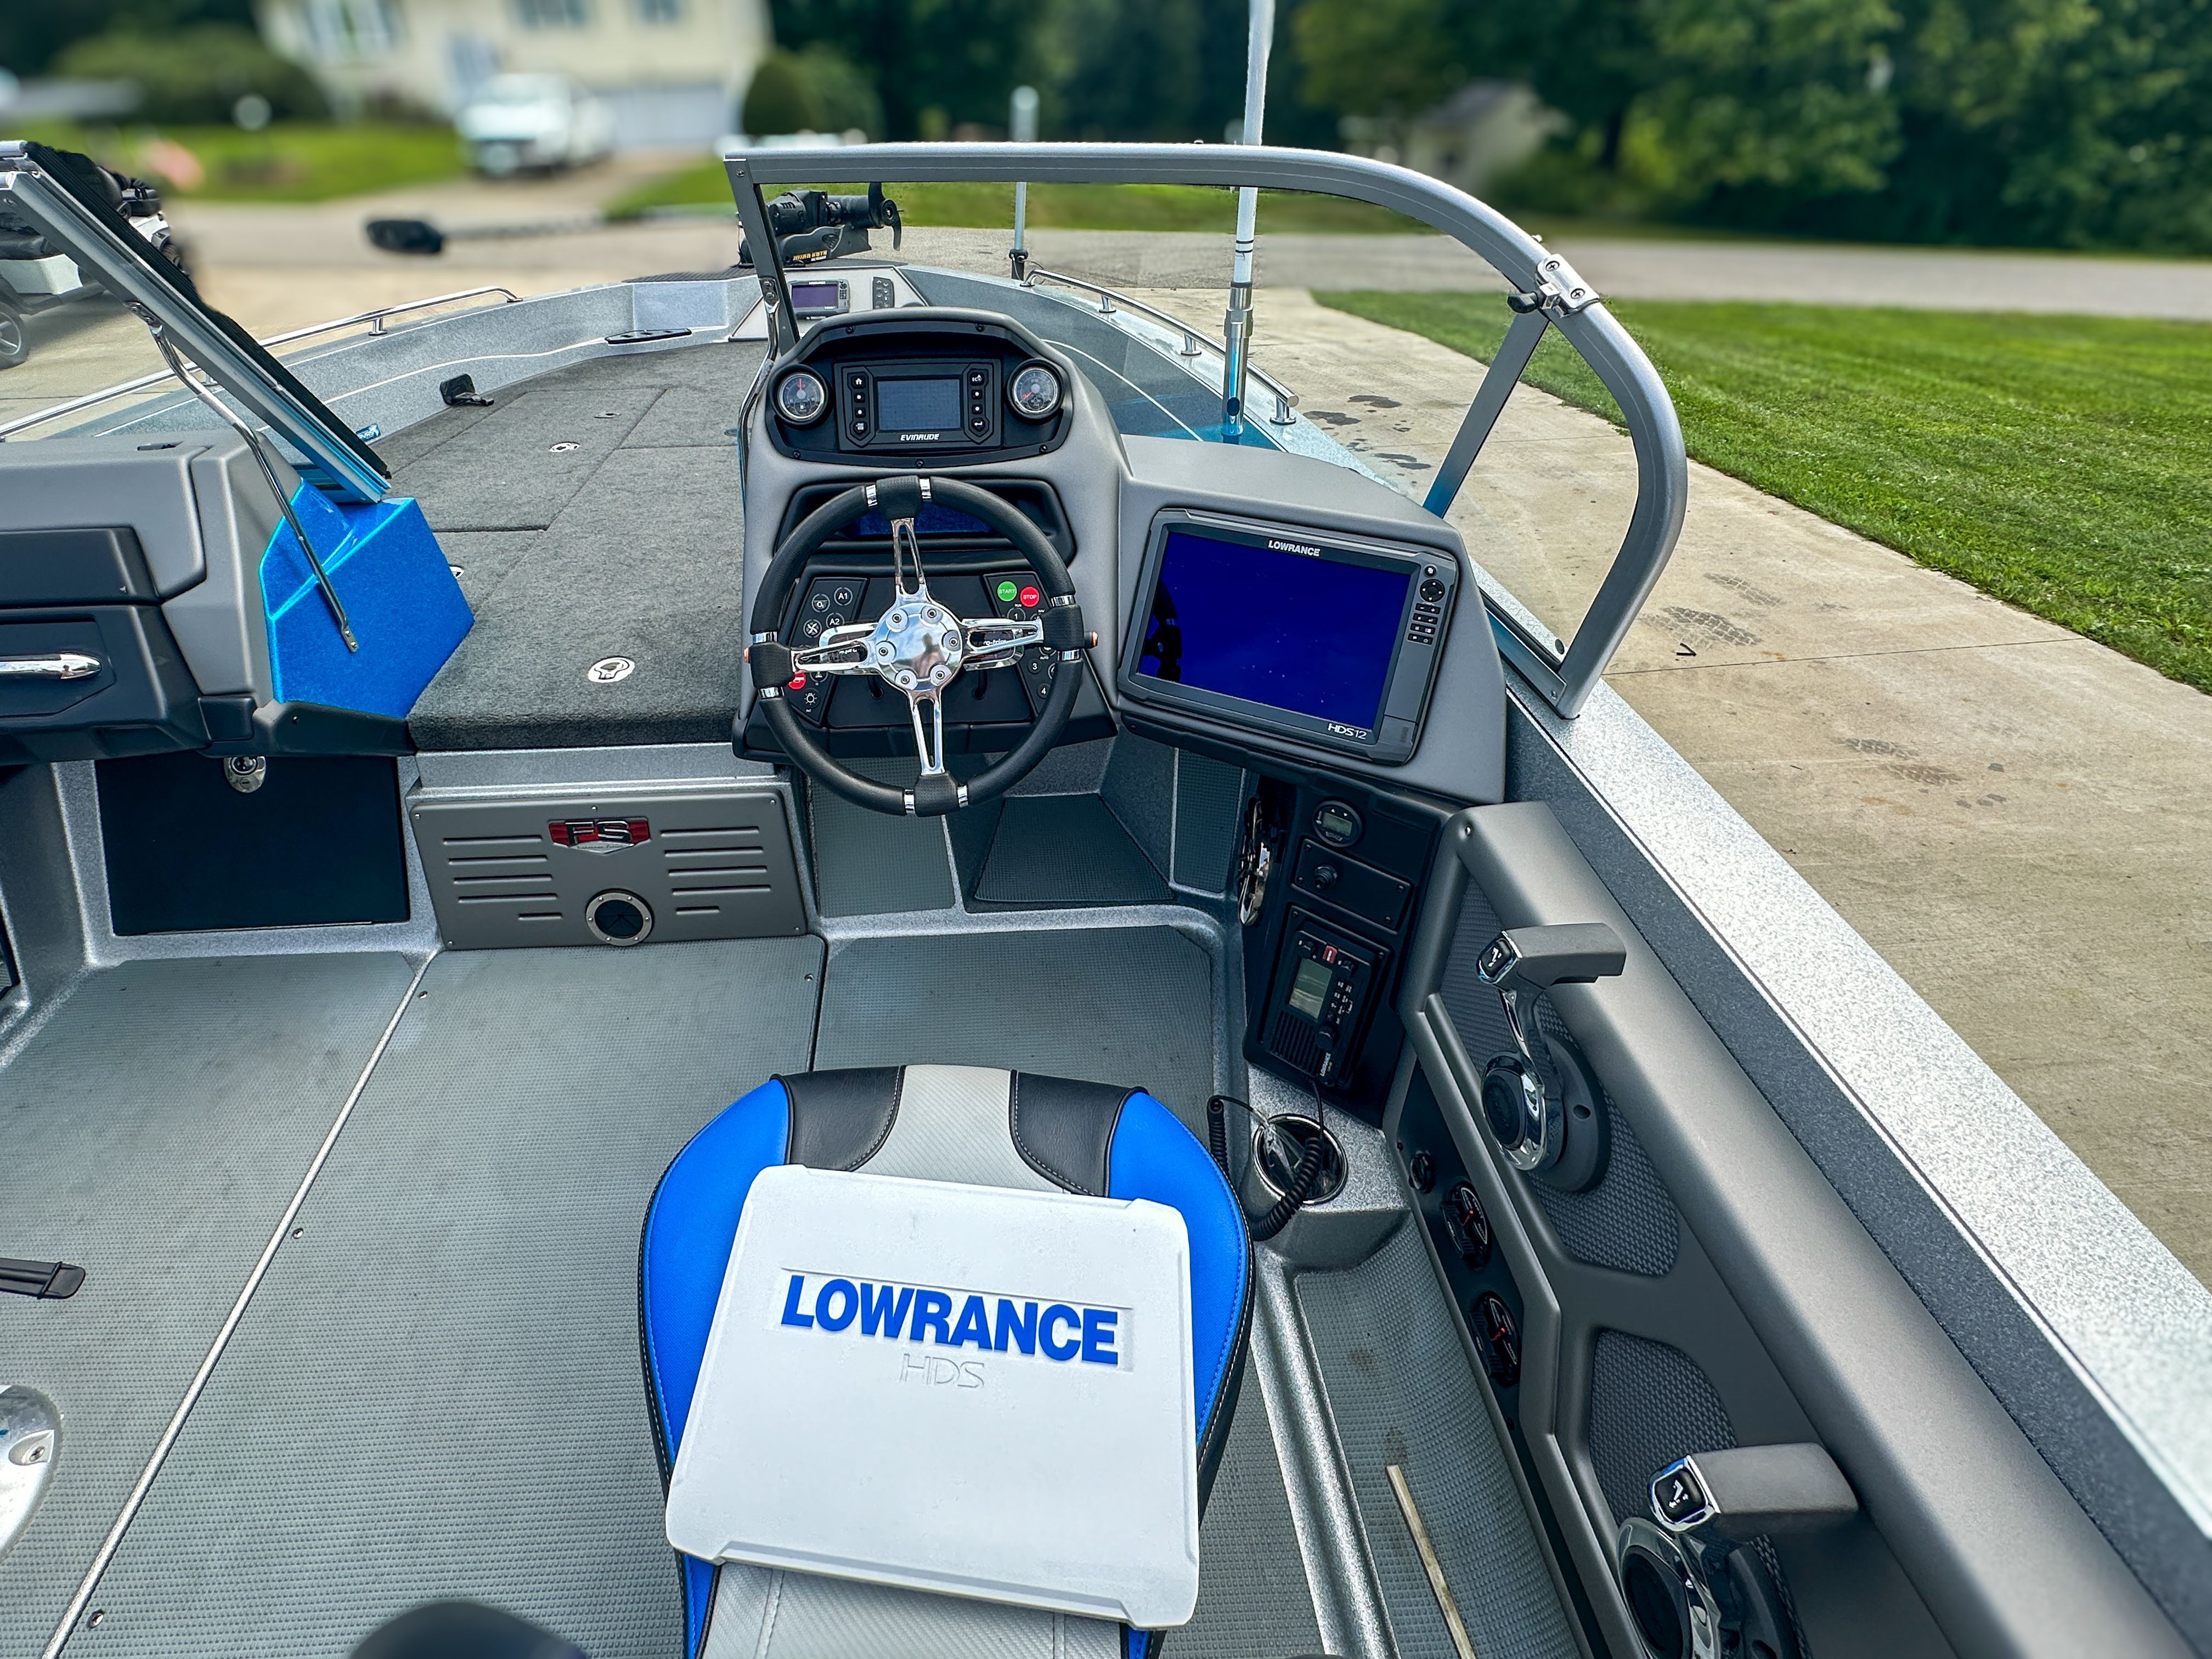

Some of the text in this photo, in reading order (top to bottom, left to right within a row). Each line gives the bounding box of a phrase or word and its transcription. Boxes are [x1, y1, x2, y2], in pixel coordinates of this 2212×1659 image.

[1268, 540, 1321, 556] LOWRANCE
[1328, 723, 1367, 740] HDS12
[565, 820, 633, 847] FS
[781, 1274, 1118, 1365] LOWRANCE
[900, 1353, 985, 1389] HDS
